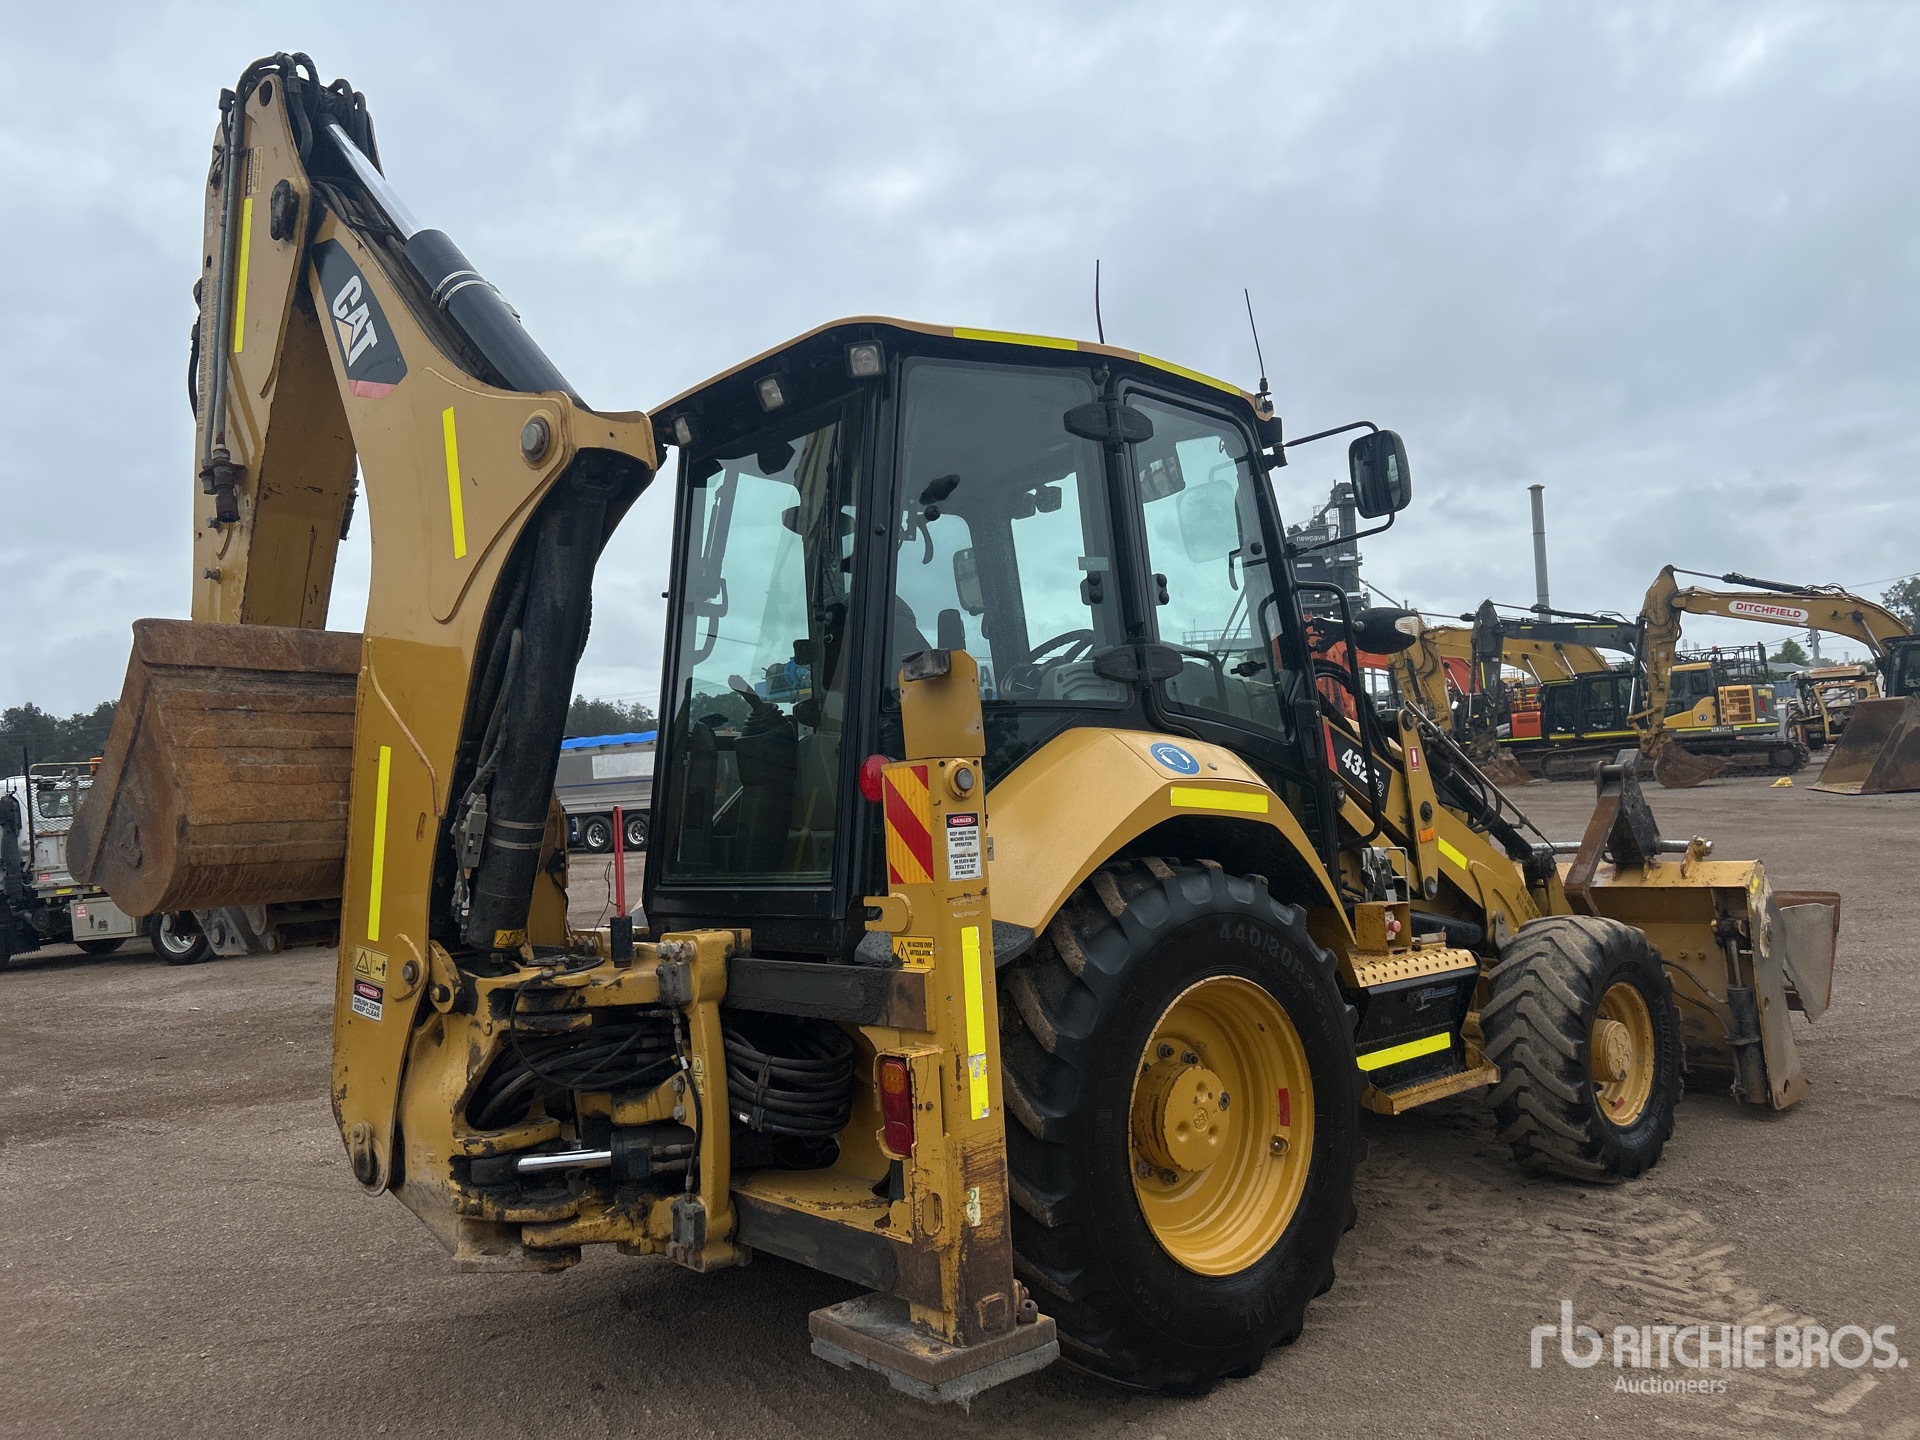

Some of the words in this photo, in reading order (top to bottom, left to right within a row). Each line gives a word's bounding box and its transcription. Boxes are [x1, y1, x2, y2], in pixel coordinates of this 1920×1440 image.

[332, 275, 379, 368] CAT
[1296, 534, 1327, 542] newpave
[1735, 602, 1802, 619] DITCHFIELD
[359, 986, 377, 997] DANGER
